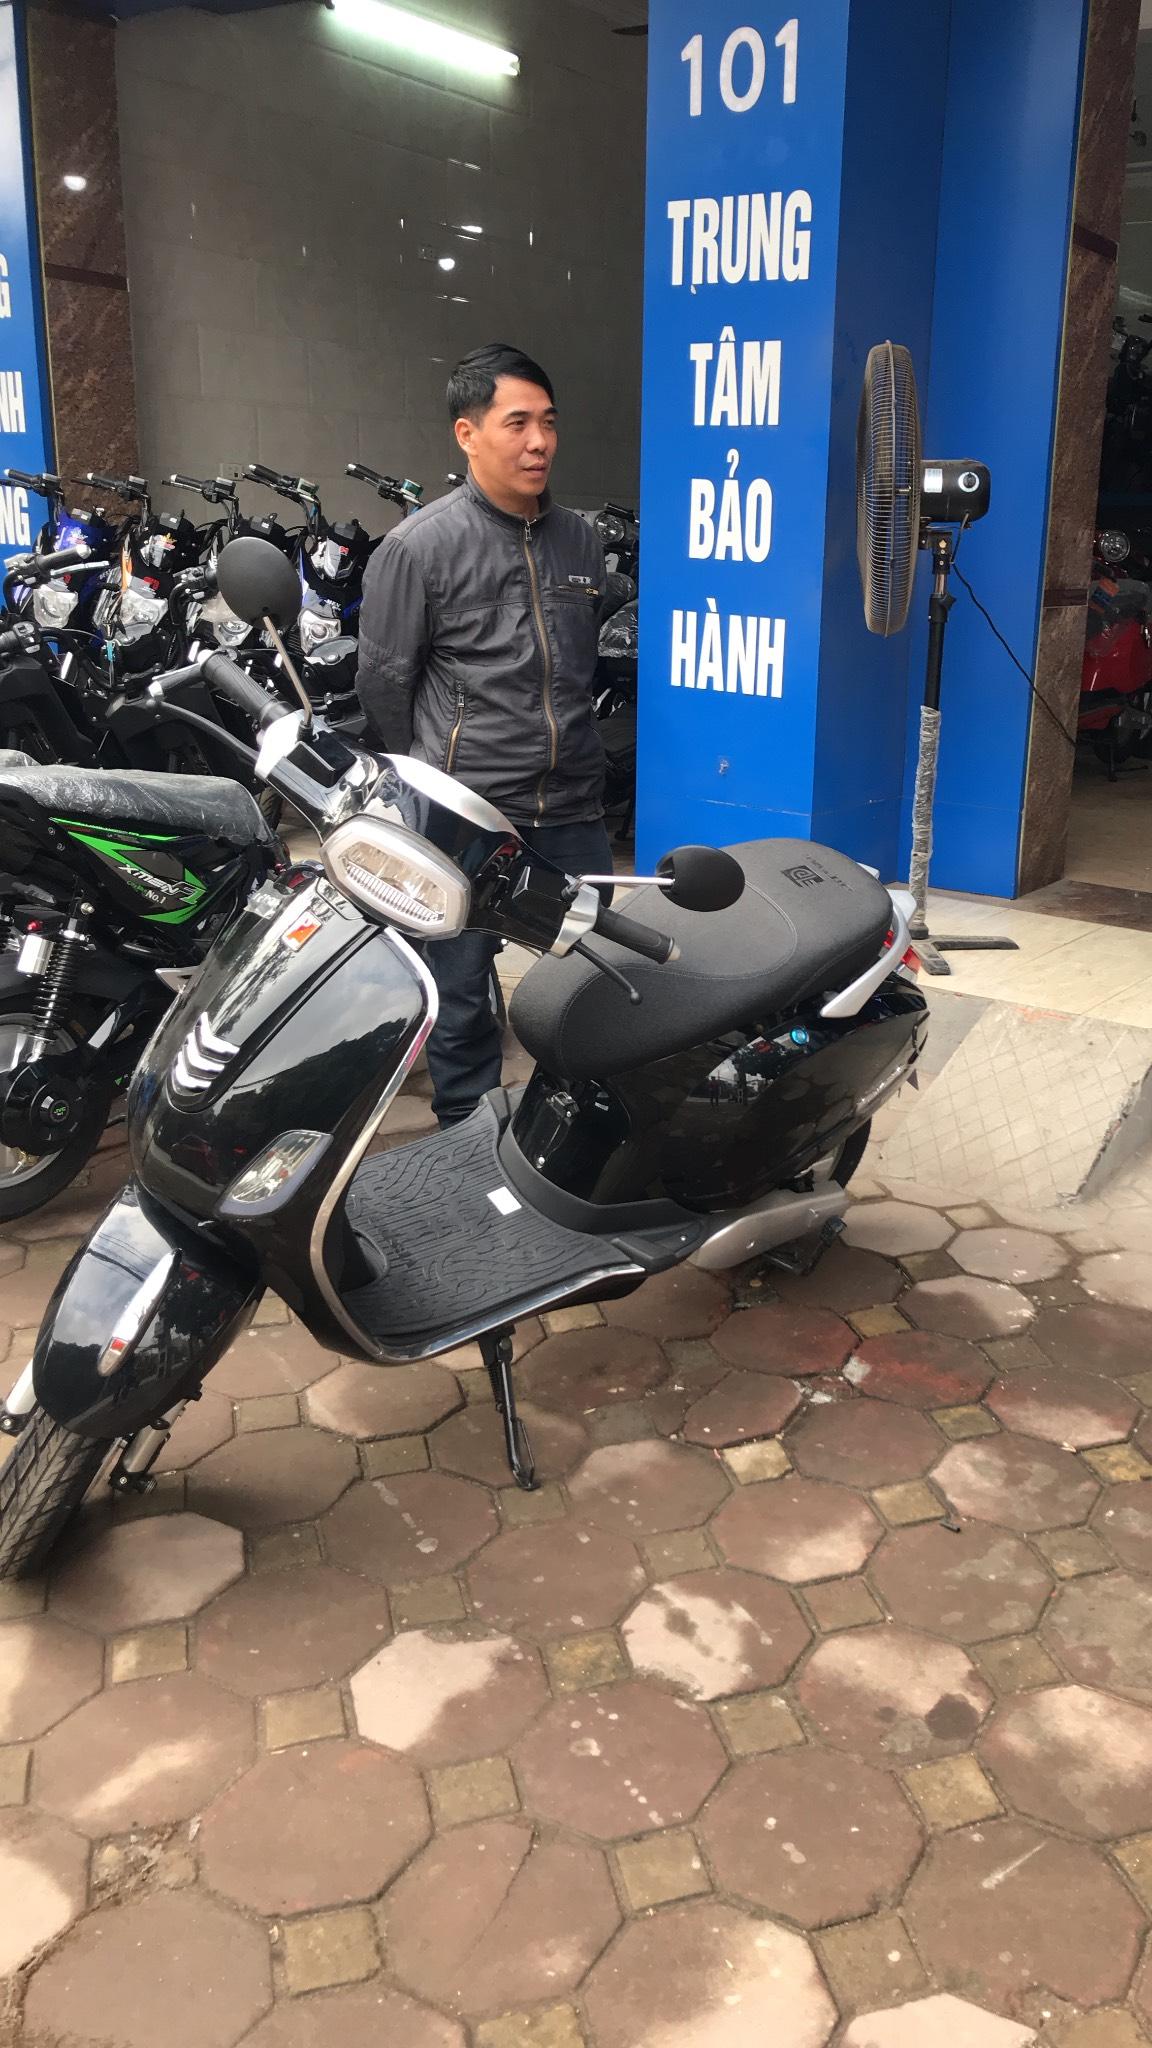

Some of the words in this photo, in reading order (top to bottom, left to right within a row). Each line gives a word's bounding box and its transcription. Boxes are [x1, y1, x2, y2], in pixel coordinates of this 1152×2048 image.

[681, 19, 798, 116] 101
[668, 190, 812, 285] TRUNG
[690, 326, 781, 426] TÂM
[689, 449, 772, 562] BẢO
[671, 598, 785, 698] HÀNH
